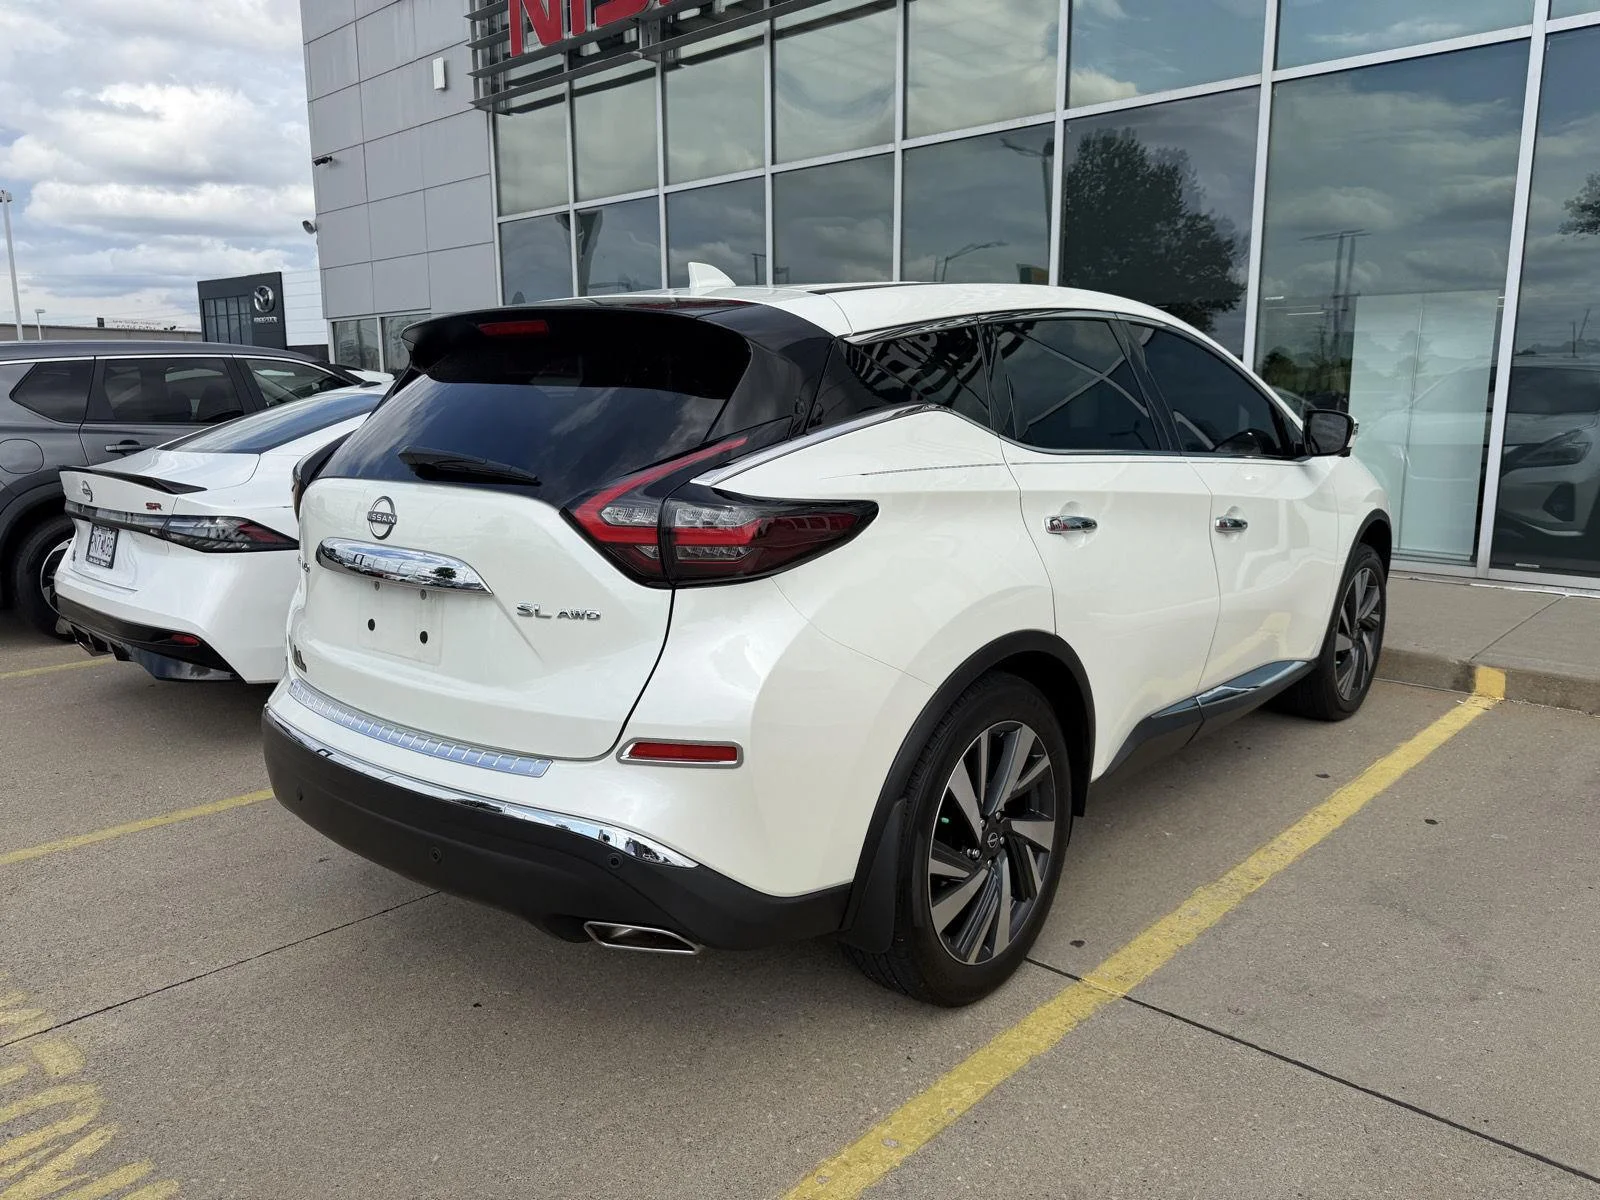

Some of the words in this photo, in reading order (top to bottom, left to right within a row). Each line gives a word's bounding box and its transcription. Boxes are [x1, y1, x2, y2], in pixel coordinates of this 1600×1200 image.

[145, 502, 163, 511] SR
[517, 603, 552, 619] SL
[557, 608, 601, 620] AWD
